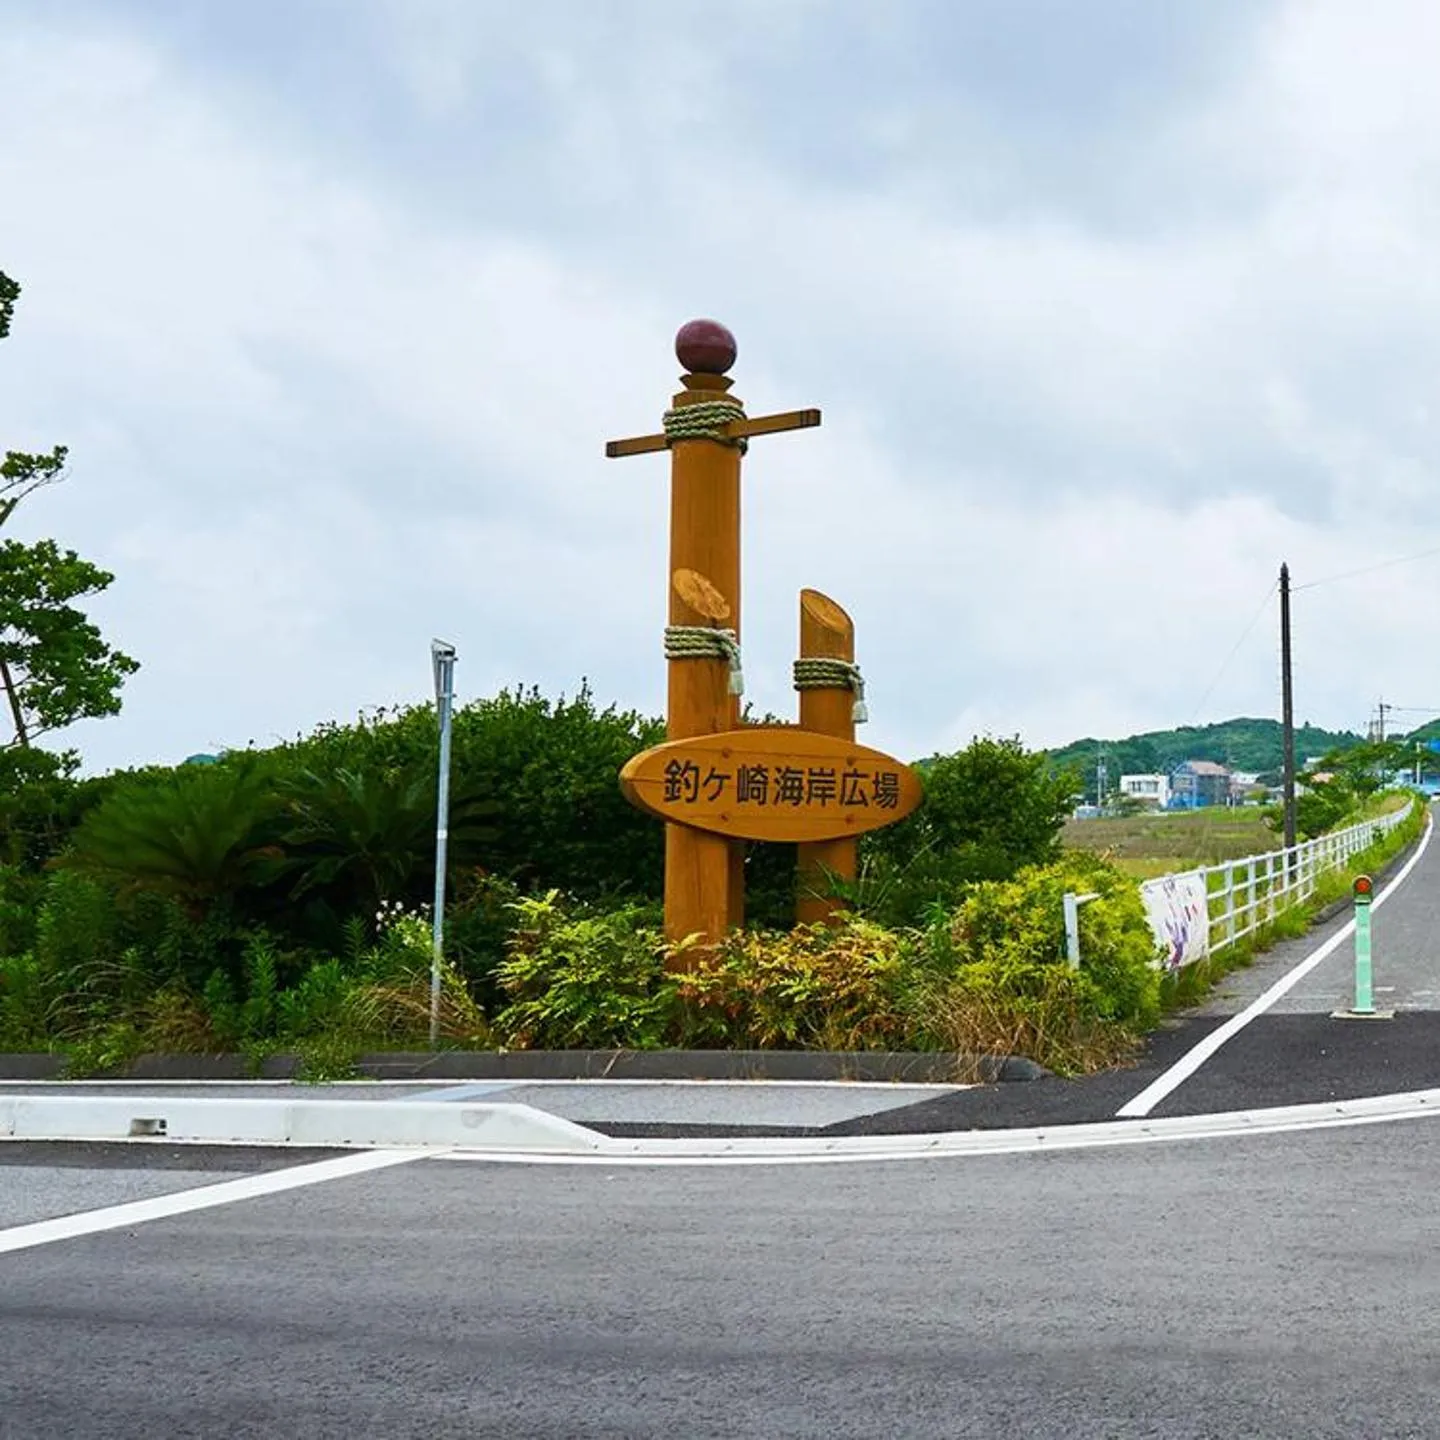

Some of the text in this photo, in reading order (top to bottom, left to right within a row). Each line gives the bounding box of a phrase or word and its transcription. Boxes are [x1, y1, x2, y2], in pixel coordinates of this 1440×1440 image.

[663, 759, 899, 809] 釣ケ崎海岸広場
